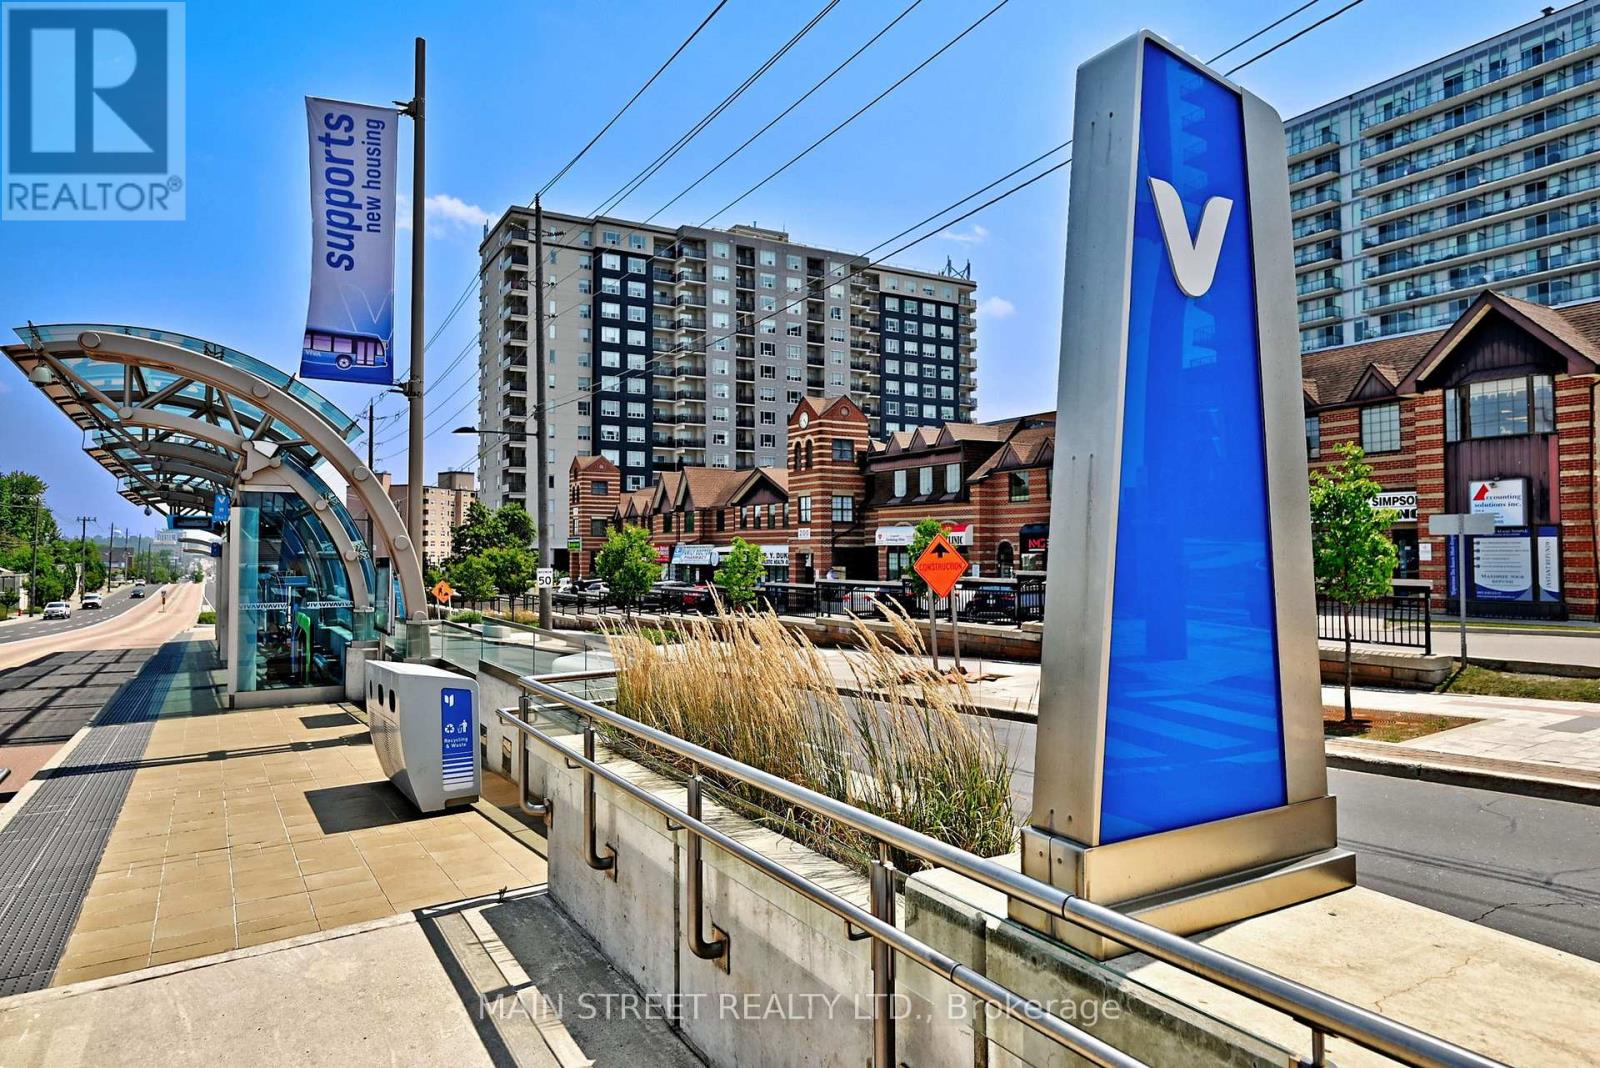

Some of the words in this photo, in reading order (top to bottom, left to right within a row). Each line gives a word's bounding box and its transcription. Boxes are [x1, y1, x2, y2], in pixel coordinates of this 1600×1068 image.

[361, 118, 385, 190] housing
[317, 112, 363, 271] supports
[366, 196, 381, 233] new
[538, 576, 552, 585] 50
[919, 562, 962, 571] CONSTRUCTION
